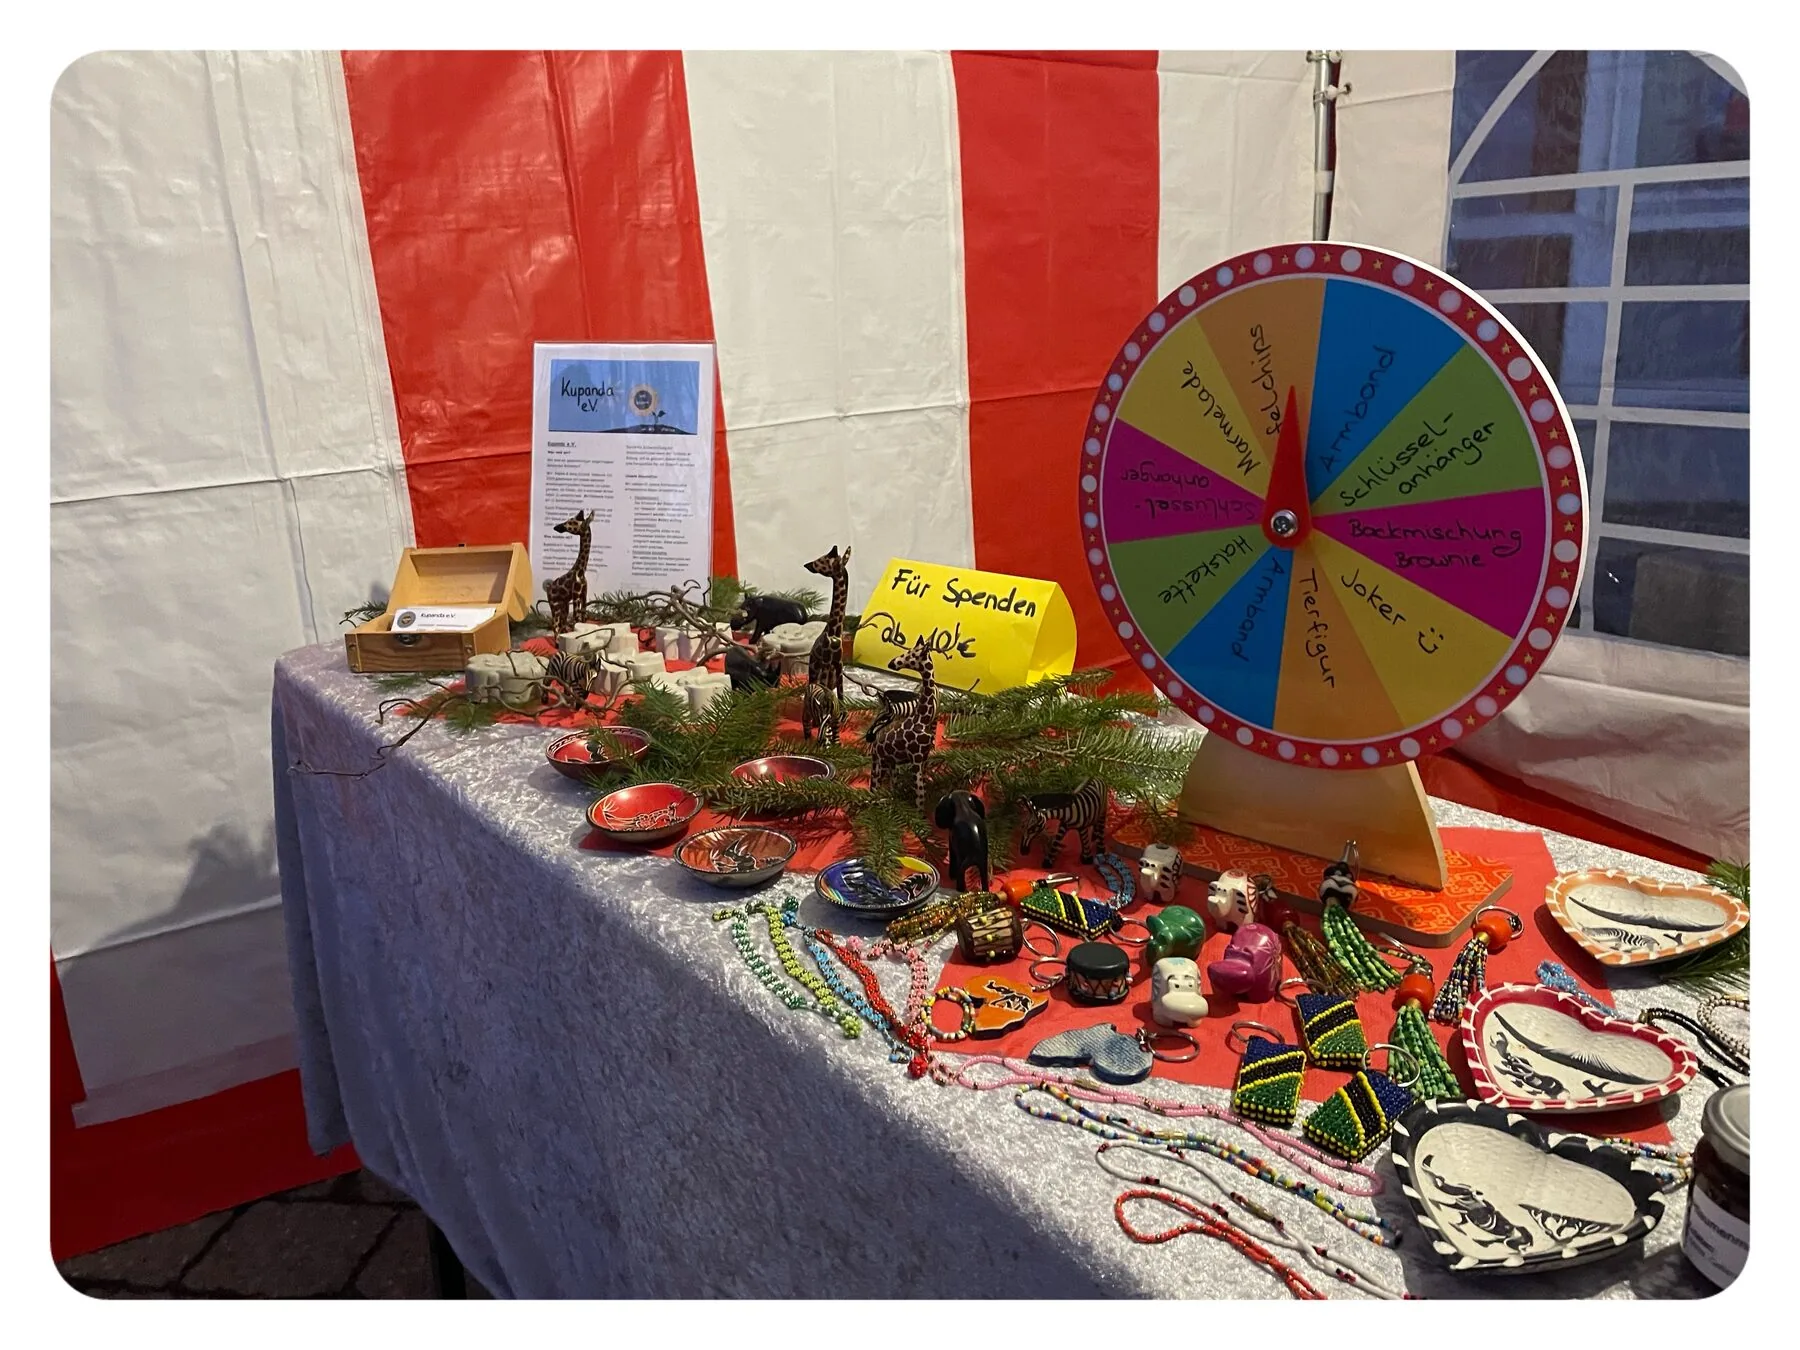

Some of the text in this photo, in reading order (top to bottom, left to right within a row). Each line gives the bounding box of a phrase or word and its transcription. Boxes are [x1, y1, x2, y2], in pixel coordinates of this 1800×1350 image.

[561, 376, 615, 407] Kupanda
[1250, 324, 1283, 436] felchips
[1319, 345, 1396, 474] Armband
[1181, 360, 1262, 477] Marmelade
[1339, 411, 1454, 508] Schlüssel-
[1398, 421, 1496, 496] anhänger
[1160, 534, 1255, 606] Halskette
[1348, 518, 1523, 558] Backmischung
[1395, 550, 1487, 570] Brownie
[891, 567, 1037, 618] Für Spenden
[1230, 556, 1284, 663] Armband
[1298, 567, 1336, 689] Tierfigur
[1340, 569, 1408, 627] Joker
[881, 621, 907, 646] ab
